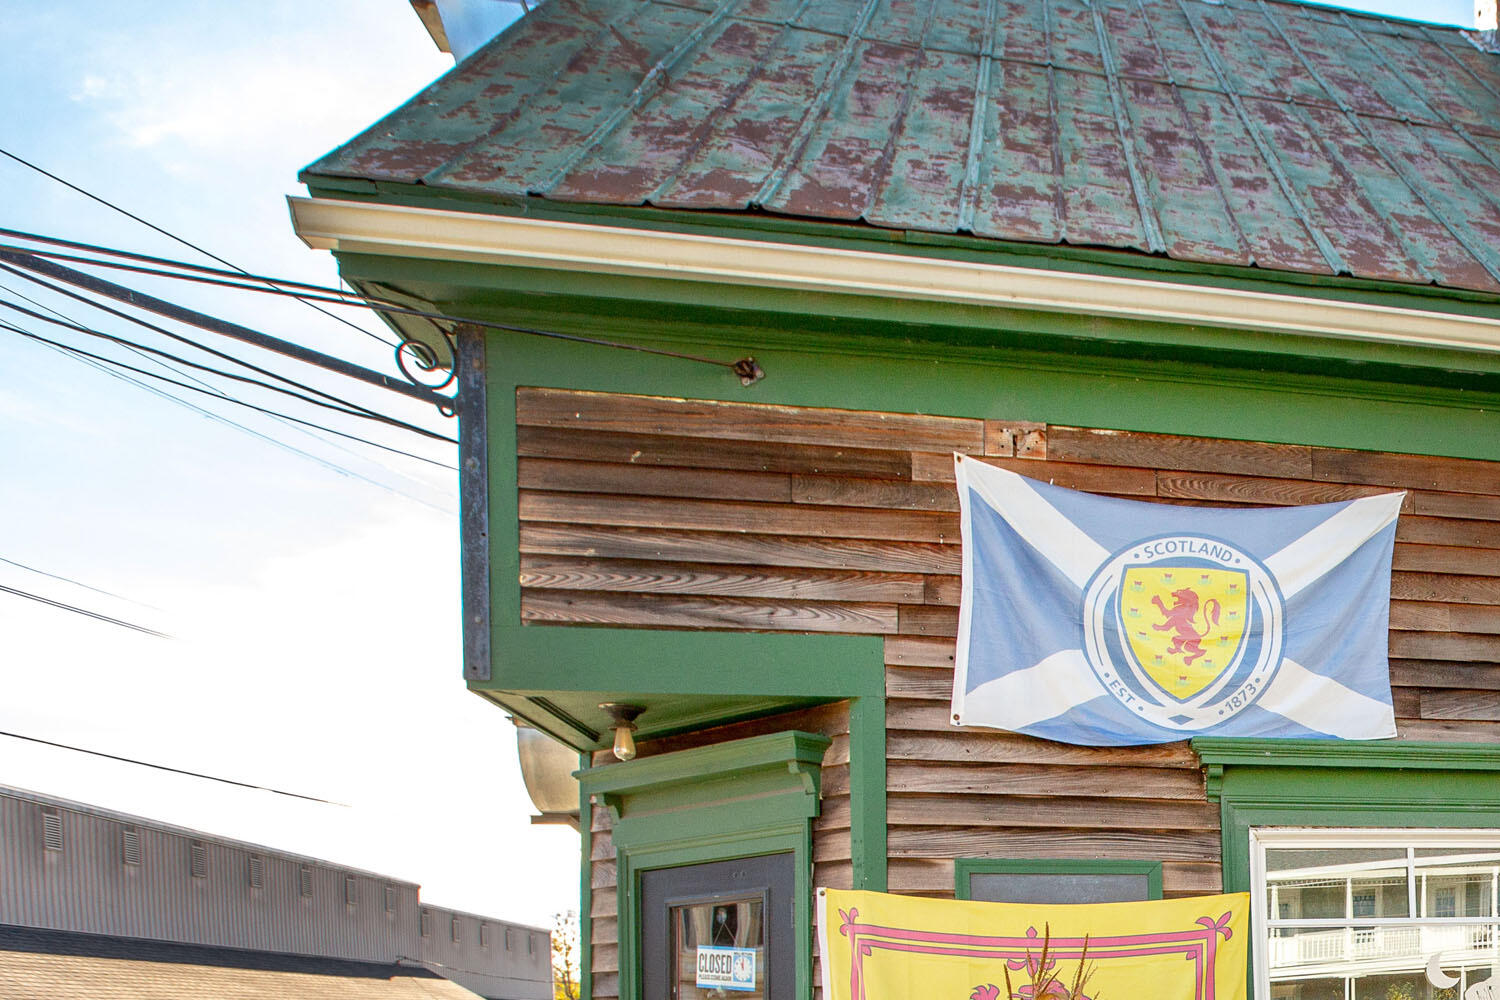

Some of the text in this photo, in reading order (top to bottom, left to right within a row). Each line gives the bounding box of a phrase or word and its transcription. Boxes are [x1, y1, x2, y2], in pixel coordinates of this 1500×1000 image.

[1143, 540, 1233, 562] SCOTLAND
[1110, 680, 1257, 712] EST 1873
[699, 953, 732, 974] CLOSED
